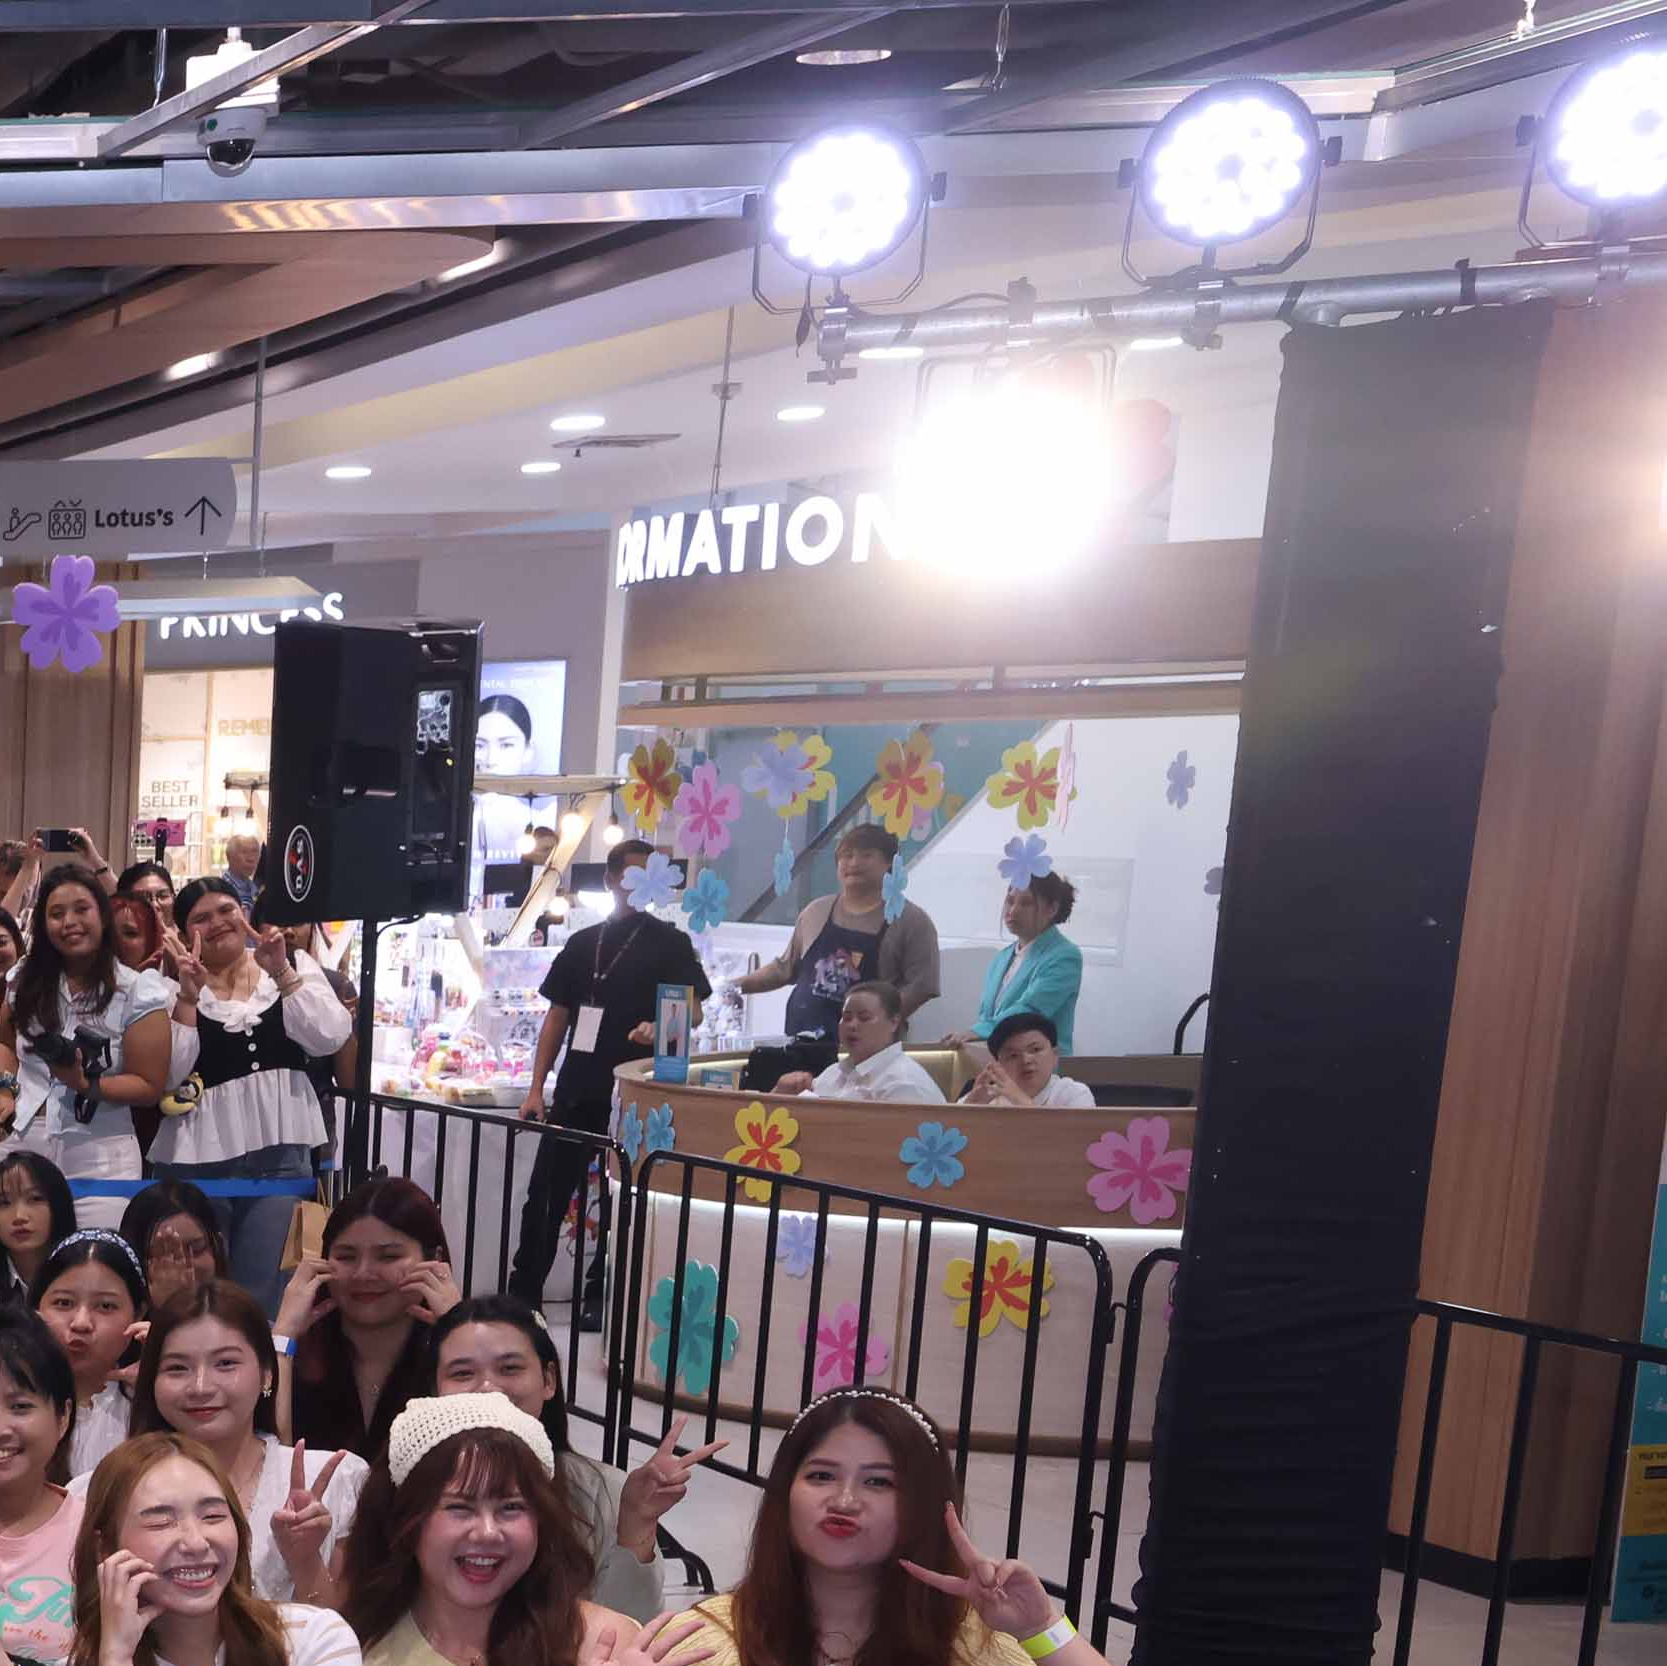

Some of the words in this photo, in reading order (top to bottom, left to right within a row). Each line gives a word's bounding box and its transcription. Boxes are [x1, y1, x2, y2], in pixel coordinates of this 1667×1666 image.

[94, 508, 174, 530] Lotus's
[151, 779, 191, 793] BEST
[141, 794, 199, 808] SELLER
